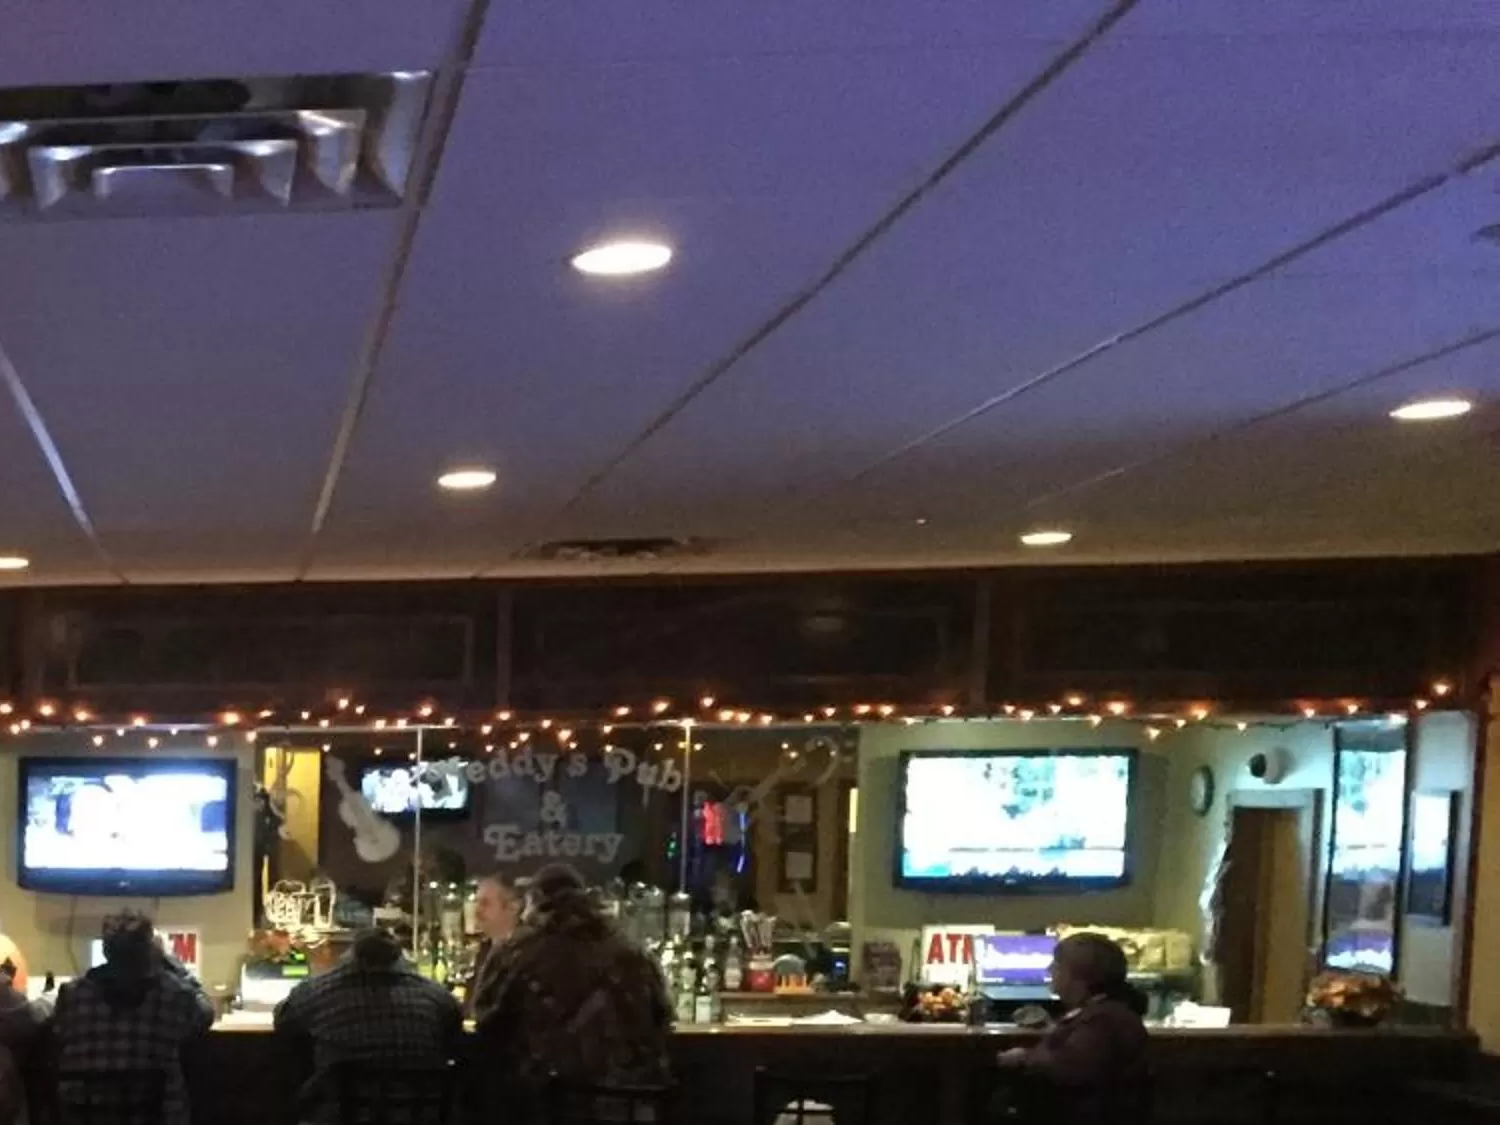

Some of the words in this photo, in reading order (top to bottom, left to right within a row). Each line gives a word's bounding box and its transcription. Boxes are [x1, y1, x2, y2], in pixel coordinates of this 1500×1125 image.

[604, 748, 682, 792] Pub
[541, 790, 566, 827] &
[484, 823, 624, 862] Eatery
